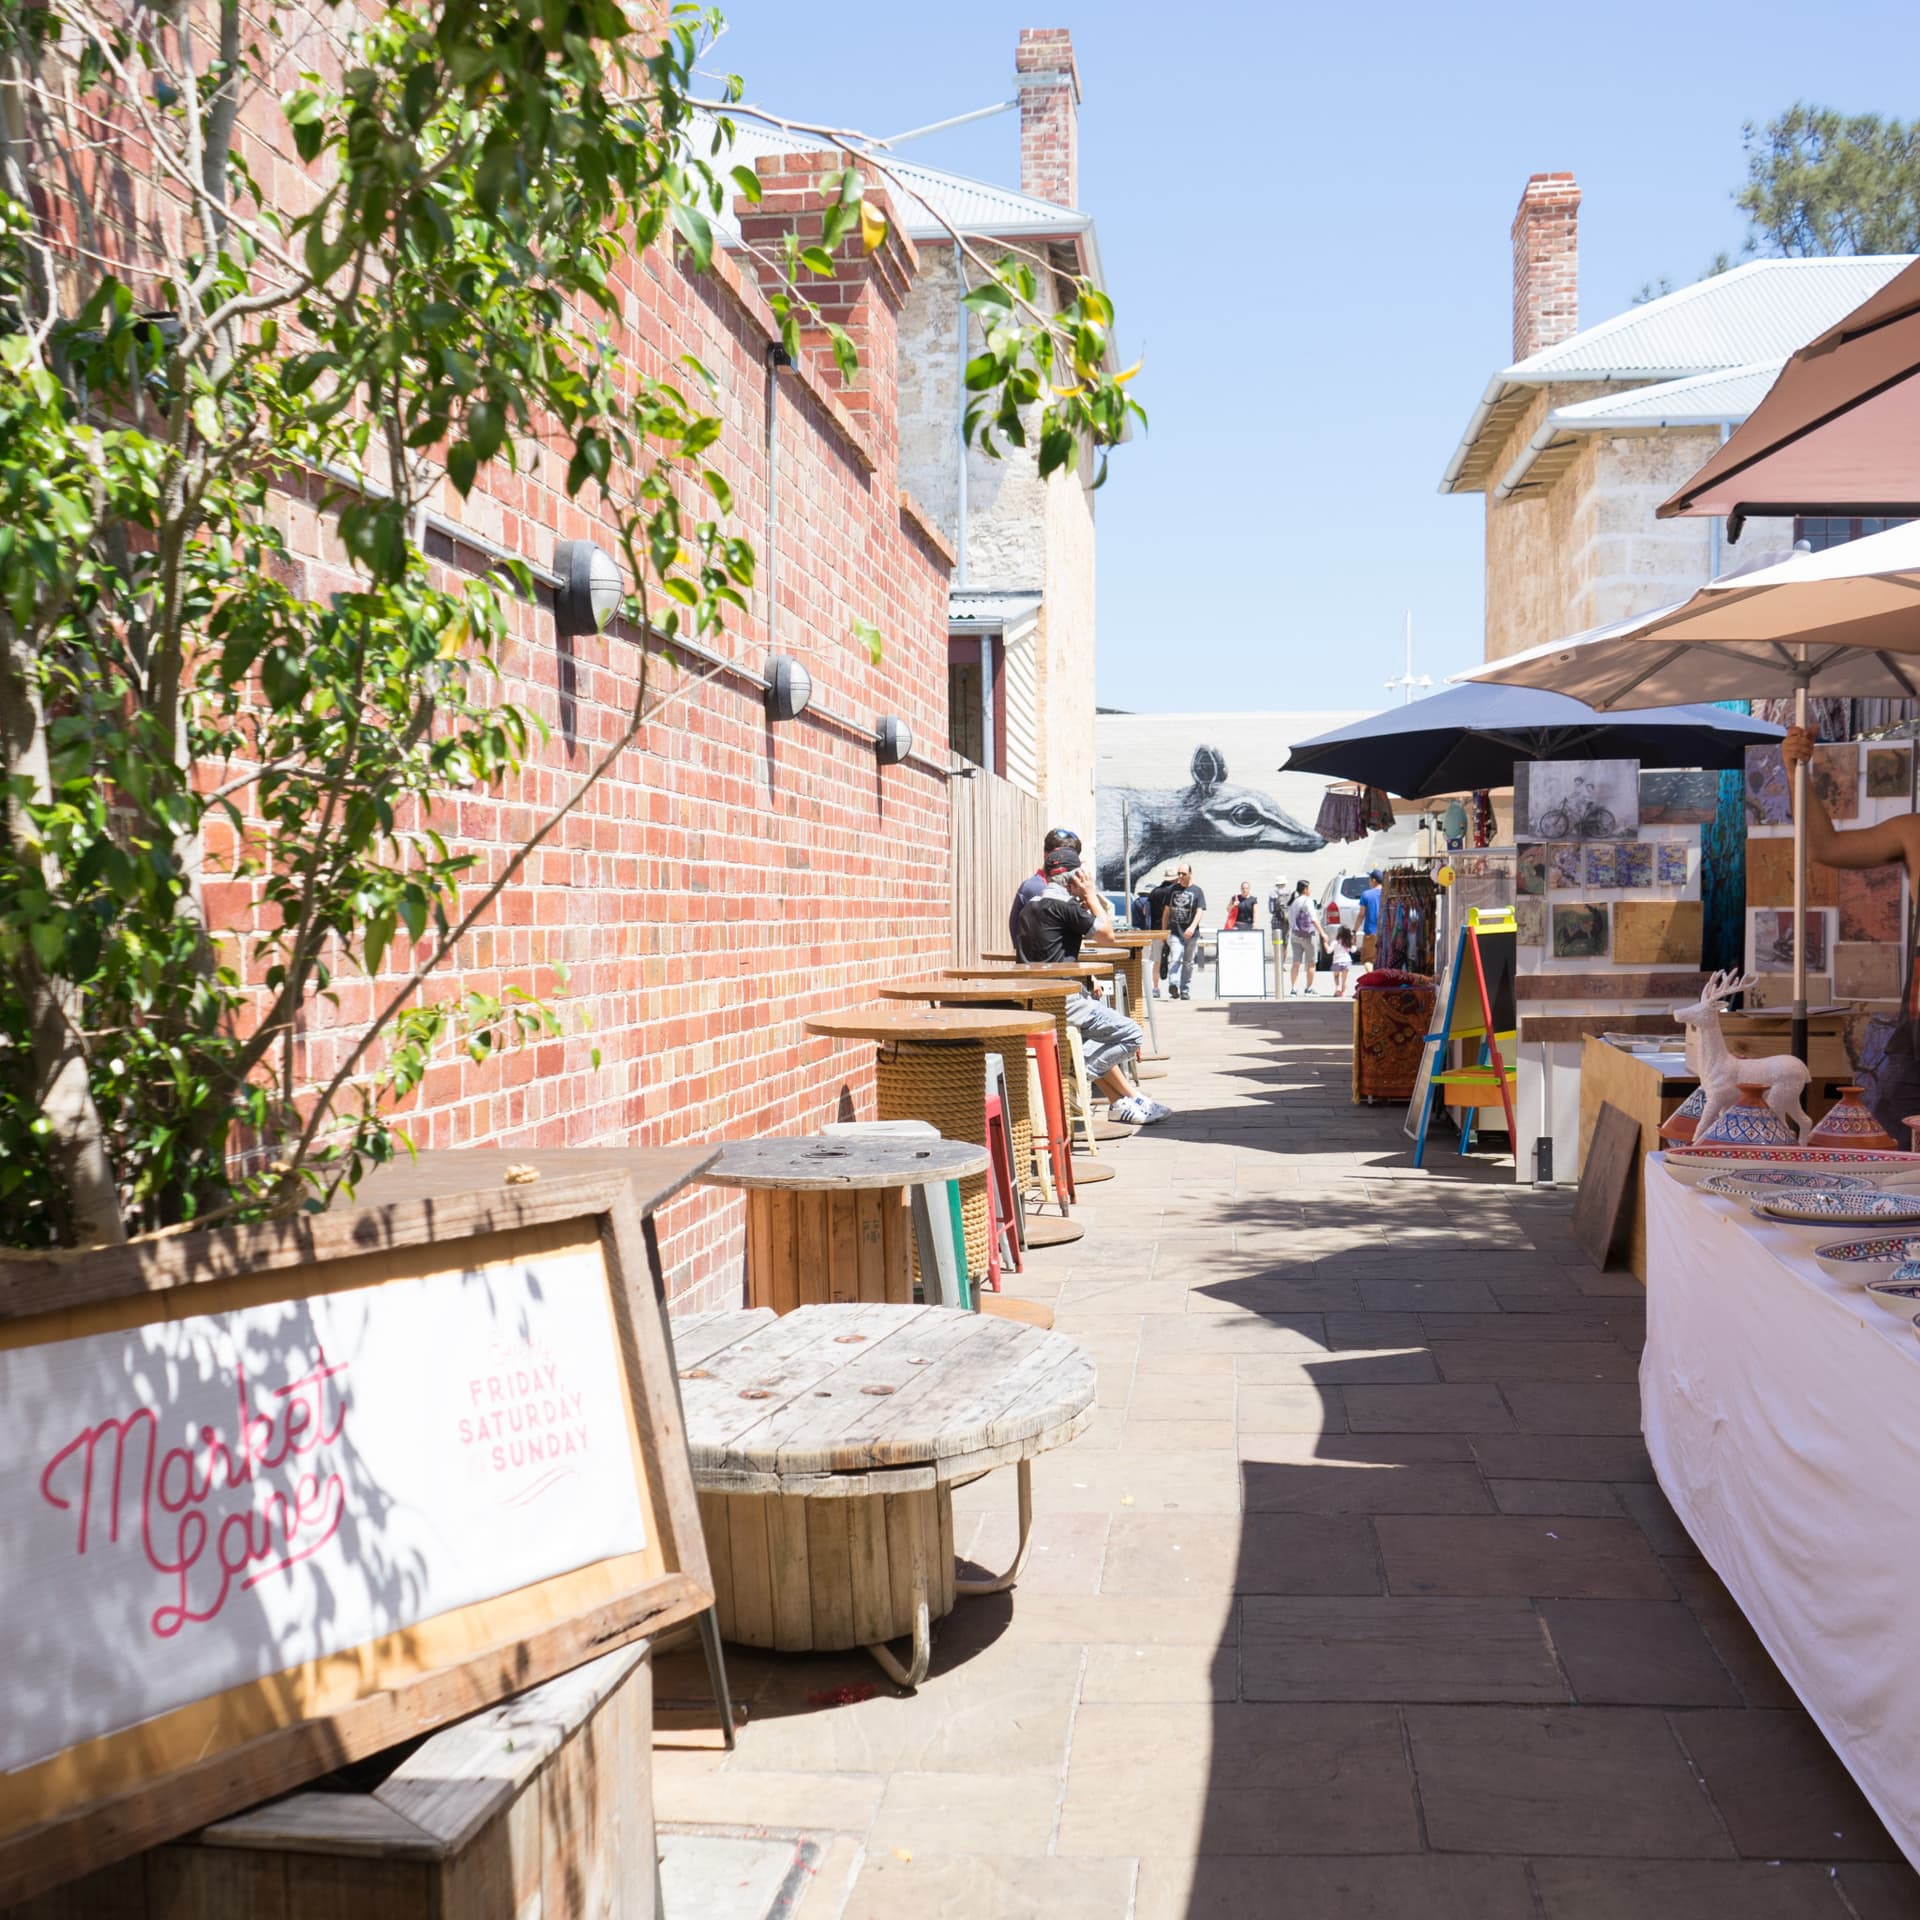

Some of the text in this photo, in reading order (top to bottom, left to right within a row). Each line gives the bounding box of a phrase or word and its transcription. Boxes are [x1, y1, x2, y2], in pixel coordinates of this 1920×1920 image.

[41, 1346, 349, 1556] Market
[459, 1392, 583, 1445] SATURDAY
[492, 1424, 588, 1472] SUNDAY
[152, 1472, 345, 1637] Lane
